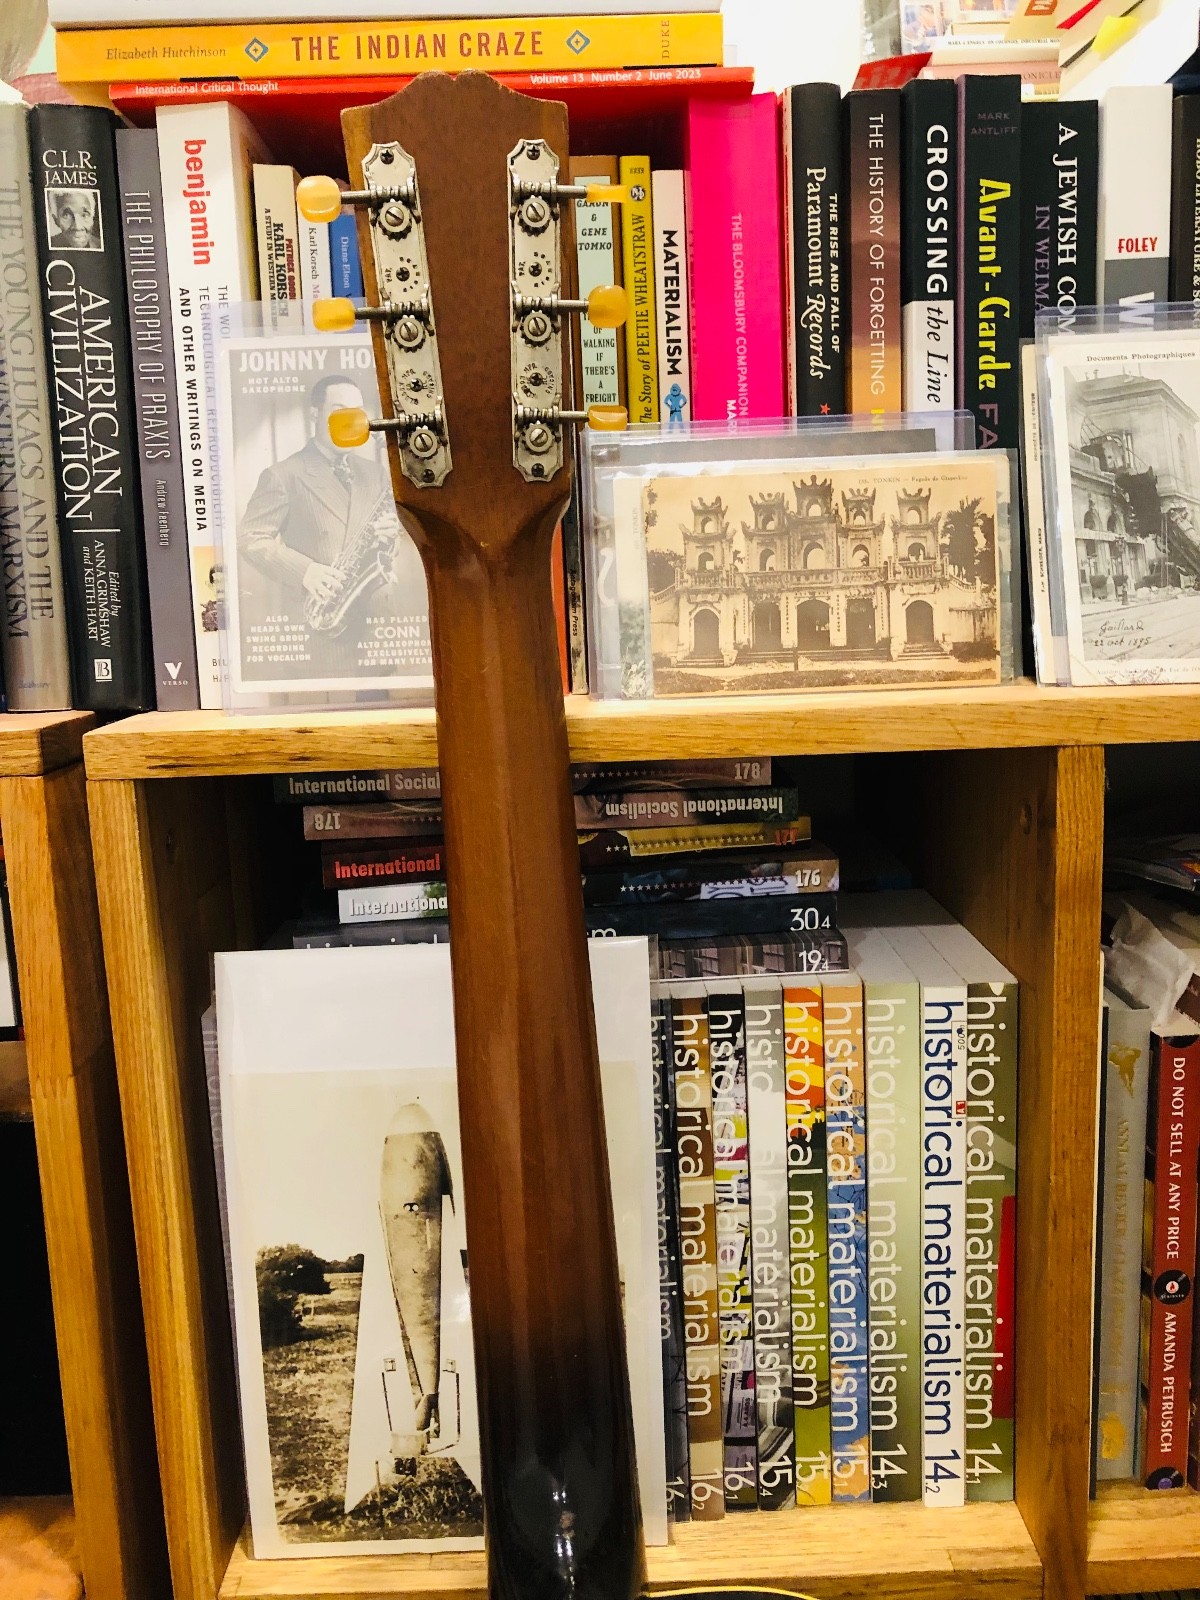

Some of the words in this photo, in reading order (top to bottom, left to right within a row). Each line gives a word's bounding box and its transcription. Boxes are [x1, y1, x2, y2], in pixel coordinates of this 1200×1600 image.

[106, 48, 159, 60] Elizabeth
[162, 46, 226, 59] Hutchinson
[291, 36, 341, 61] THE
[356, 33, 447, 60] INDIAN
[459, 31, 543, 58] CRAZE
[661, 20, 670, 59] DUKE
[135, 83, 199, 96] International
[201, 82, 235, 93] Critical
[238, 81, 279, 94] Thought
[530, 74, 569, 85] Volume
[573, 73, 585, 83] 13
[591, 72, 632, 83] Number
[635, 71, 642, 81] 2
[648, 70, 673, 81] June
[676, 69, 701, 80] 2023
[869, 114, 884, 149] THE
[970, 126, 1018, 135] ANTLIFF
[978, 113, 1010, 121] MARK
[1059, 123, 1078, 146] A
[42, 149, 97, 170] C.L.R.
[45, 170, 98, 187] JAMES
[0, 180, 25, 240] THE
[125, 190, 153, 224] THE
[183, 140, 214, 265] benjamin
[829, 193, 838, 222] THE
[869, 157, 884, 237] HISTORY
[926, 124, 949, 294] CROSSING
[1052, 154, 1078, 266] JEWISH
[581, 227, 608, 236] GENE
[591, 213, 597, 222] &
[731, 213, 743, 240] THE
[806, 167, 826, 287] Paramount
[1035, 205, 1050, 230] IN
[273, 222, 285, 260] KARL
[309, 227, 317, 248] Karl
[340, 236, 350, 262] Diane
[578, 242, 612, 250] TOMKO
[829, 226, 839, 258] RISE
[1118, 237, 1158, 254] FOLEY
[310, 250, 320, 280] Korsch
[632, 214, 648, 307] WHEATSTRAW
[869, 244, 885, 269] OF
[343, 264, 351, 288] Elson
[732, 243, 746, 333] BLOOMSBURY
[830, 262, 839, 292] AND
[3, 250, 35, 356] YOUNG
[129, 234, 163, 353] PHILOSOPHY
[179, 288, 193, 318] AND
[218, 285, 230, 309] THE
[662, 230, 684, 376] MATERIALISM
[830, 297, 840, 331] FALL
[926, 306, 949, 342] the
[583, 338, 615, 348] WALKING
[636, 309, 650, 356] PEETIE
[800, 293, 831, 379] Records
[831, 335, 840, 353] OF
[870, 277, 885, 395] FORGETTING
[182, 325, 196, 373] OTHER
[239, 350, 328, 373] JOHNNY
[596, 352, 604, 362] IF
[139, 362, 165, 384] OF
[585, 366, 615, 376] THERE'S
[642, 359, 651, 371] of
[735, 337, 749, 416] COMPANION
[926, 350, 949, 404] Line
[46, 259, 93, 521] CIVILIZATION
[79, 286, 123, 497] AMERICAN
[242, 384, 306, 394] SAXOPHONE
[272, 377, 299, 385] ALTO
[598, 380, 603, 389] A
[640, 373, 654, 403] Story
[585, 393, 617, 403] FREIGHT
[12, 365, 45, 481] LUKACS
[142, 393, 171, 460] PRAXIS
[186, 379, 202, 451] WRITINGS
[192, 459, 203, 477] ON
[156, 480, 167, 510] Andrew
[194, 485, 208, 531] MEDIA
[22, 492, 50, 559] AND
[83, 546, 94, 565] and
[94, 540, 106, 578] ANNA
[1, 504, 29, 639] MARXISM
[84, 568, 96, 605] KEITH
[109, 571, 120, 602] Edited
[28, 565, 54, 620] THE
[87, 607, 99, 641] HART
[97, 579, 111, 648] GRIMSHAW
[111, 604, 121, 616] by
[265, 615, 289, 623] ALSO
[246, 635, 276, 643] SWING
[279, 634, 310, 642] GROUP
[250, 625, 281, 633] HEADS
[284, 624, 305, 632] OWN
[374, 626, 420, 639] CONN
[571, 615, 580, 637] Press
[246, 655, 264, 663] FOR
[252, 645, 305, 653] RECORDING
[357, 641, 380, 649] ALTO
[289, 773, 390, 795] International
[734, 762, 761, 780] 178
[314, 811, 341, 831] 178
[605, 799, 679, 820] Socialism
[683, 796, 783, 818] International
[335, 853, 440, 879] International
[795, 868, 821, 888] 176
[1172, 1057, 1186, 1081] DO
[673, 1013, 713, 1186] historical
[709, 1009, 748, 1171] historical
[784, 1001, 823, 1179] historical
[823, 1002, 865, 1190] historical
[867, 998, 907, 1187] historical
[924, 1001, 965, 1191] historical
[966, 996, 1007, 1186] historical
[1171, 1086, 1185, 1118] NOT
[1169, 1123, 1183, 1158] SELL
[1168, 1161, 1182, 1178] AT
[1167, 1182, 1181, 1213] ANY
[1166, 1216, 1180, 1260] PRICE
[716, 1181, 751, 1375] materialism
[680, 1203, 718, 1417] materialism
[750, 1194, 789, 1404] materialism
[789, 1189, 826, 1406] materialism
[966, 1197, 1004, 1429] materialism
[828, 1201, 867, 1432] materialism
[869, 1199, 908, 1430] materialism
[924, 1203, 962, 1436] materialism
[1163, 1311, 1177, 1373] AMANDA
[1160, 1376, 1175, 1453] PETRUSICH
